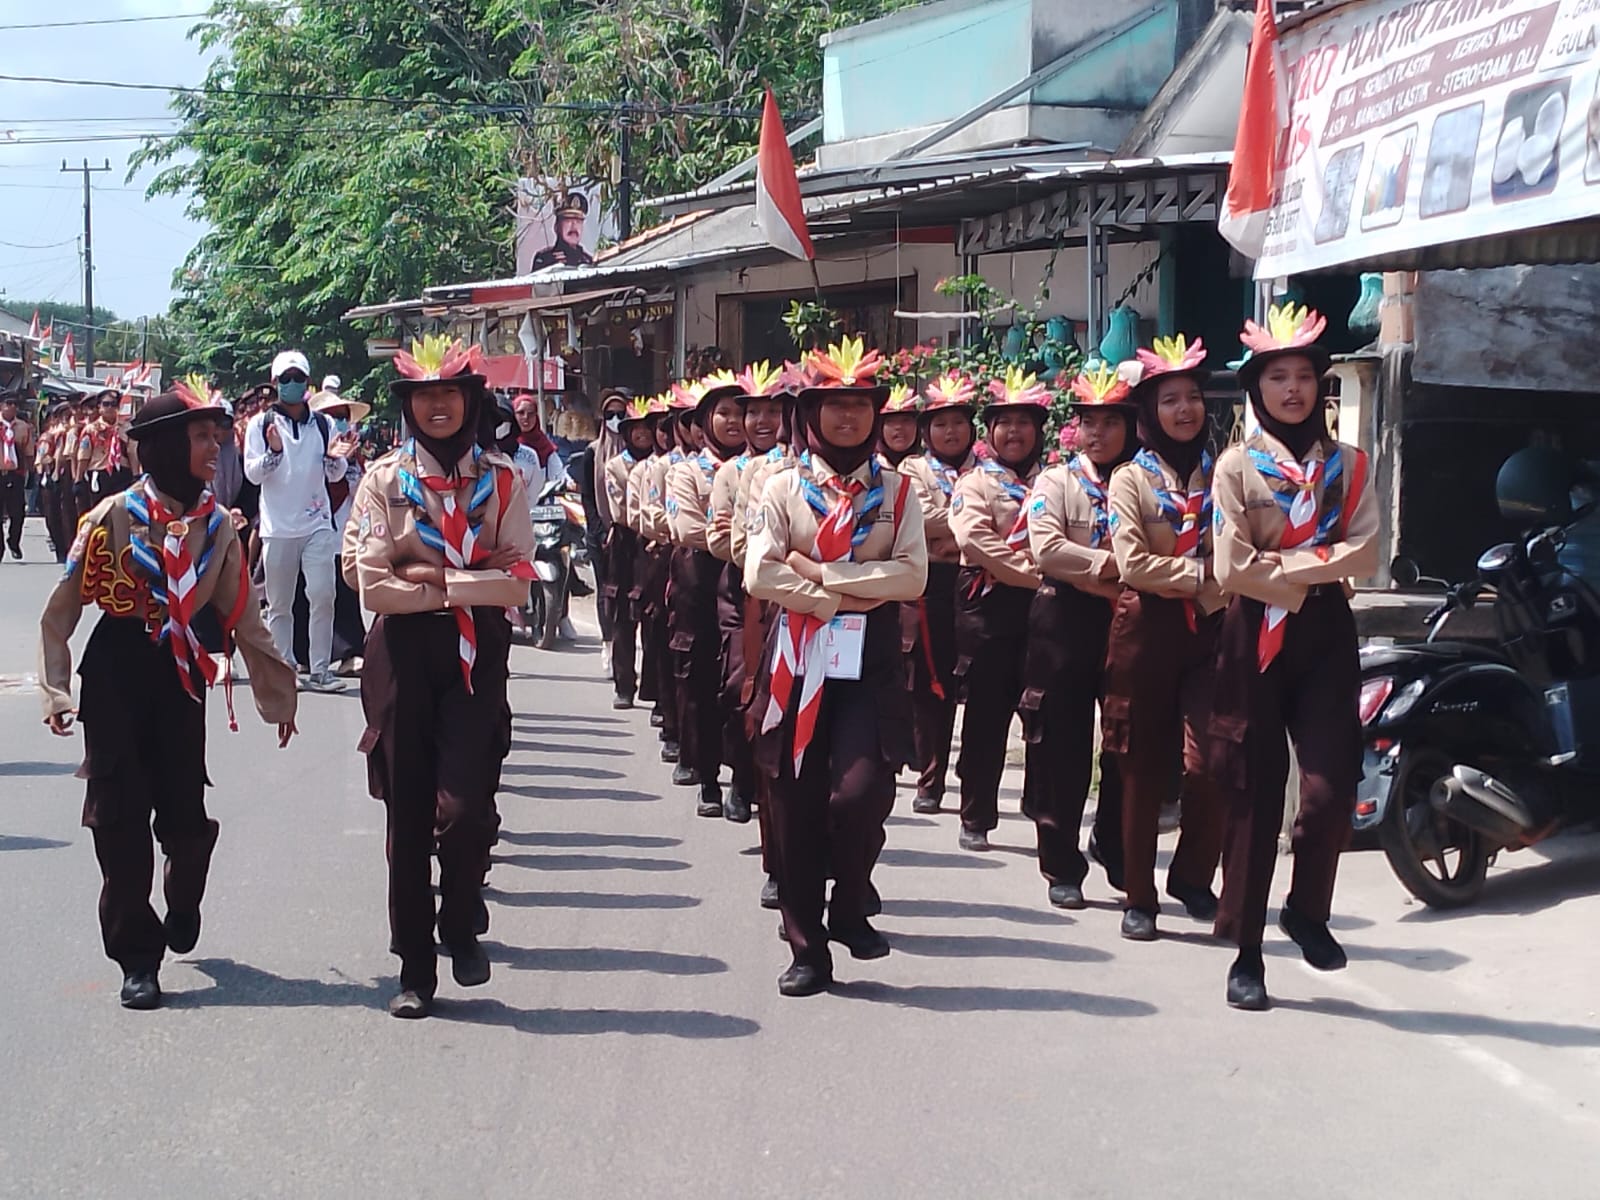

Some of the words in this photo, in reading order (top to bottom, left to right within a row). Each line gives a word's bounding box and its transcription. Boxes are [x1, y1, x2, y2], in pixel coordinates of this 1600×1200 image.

[1495, 14, 1532, 47] NASI
[1556, 23, 1597, 57] GULA
[1393, 80, 1433, 113] PLASTIK
[1512, 44, 1539, 74] DLL
